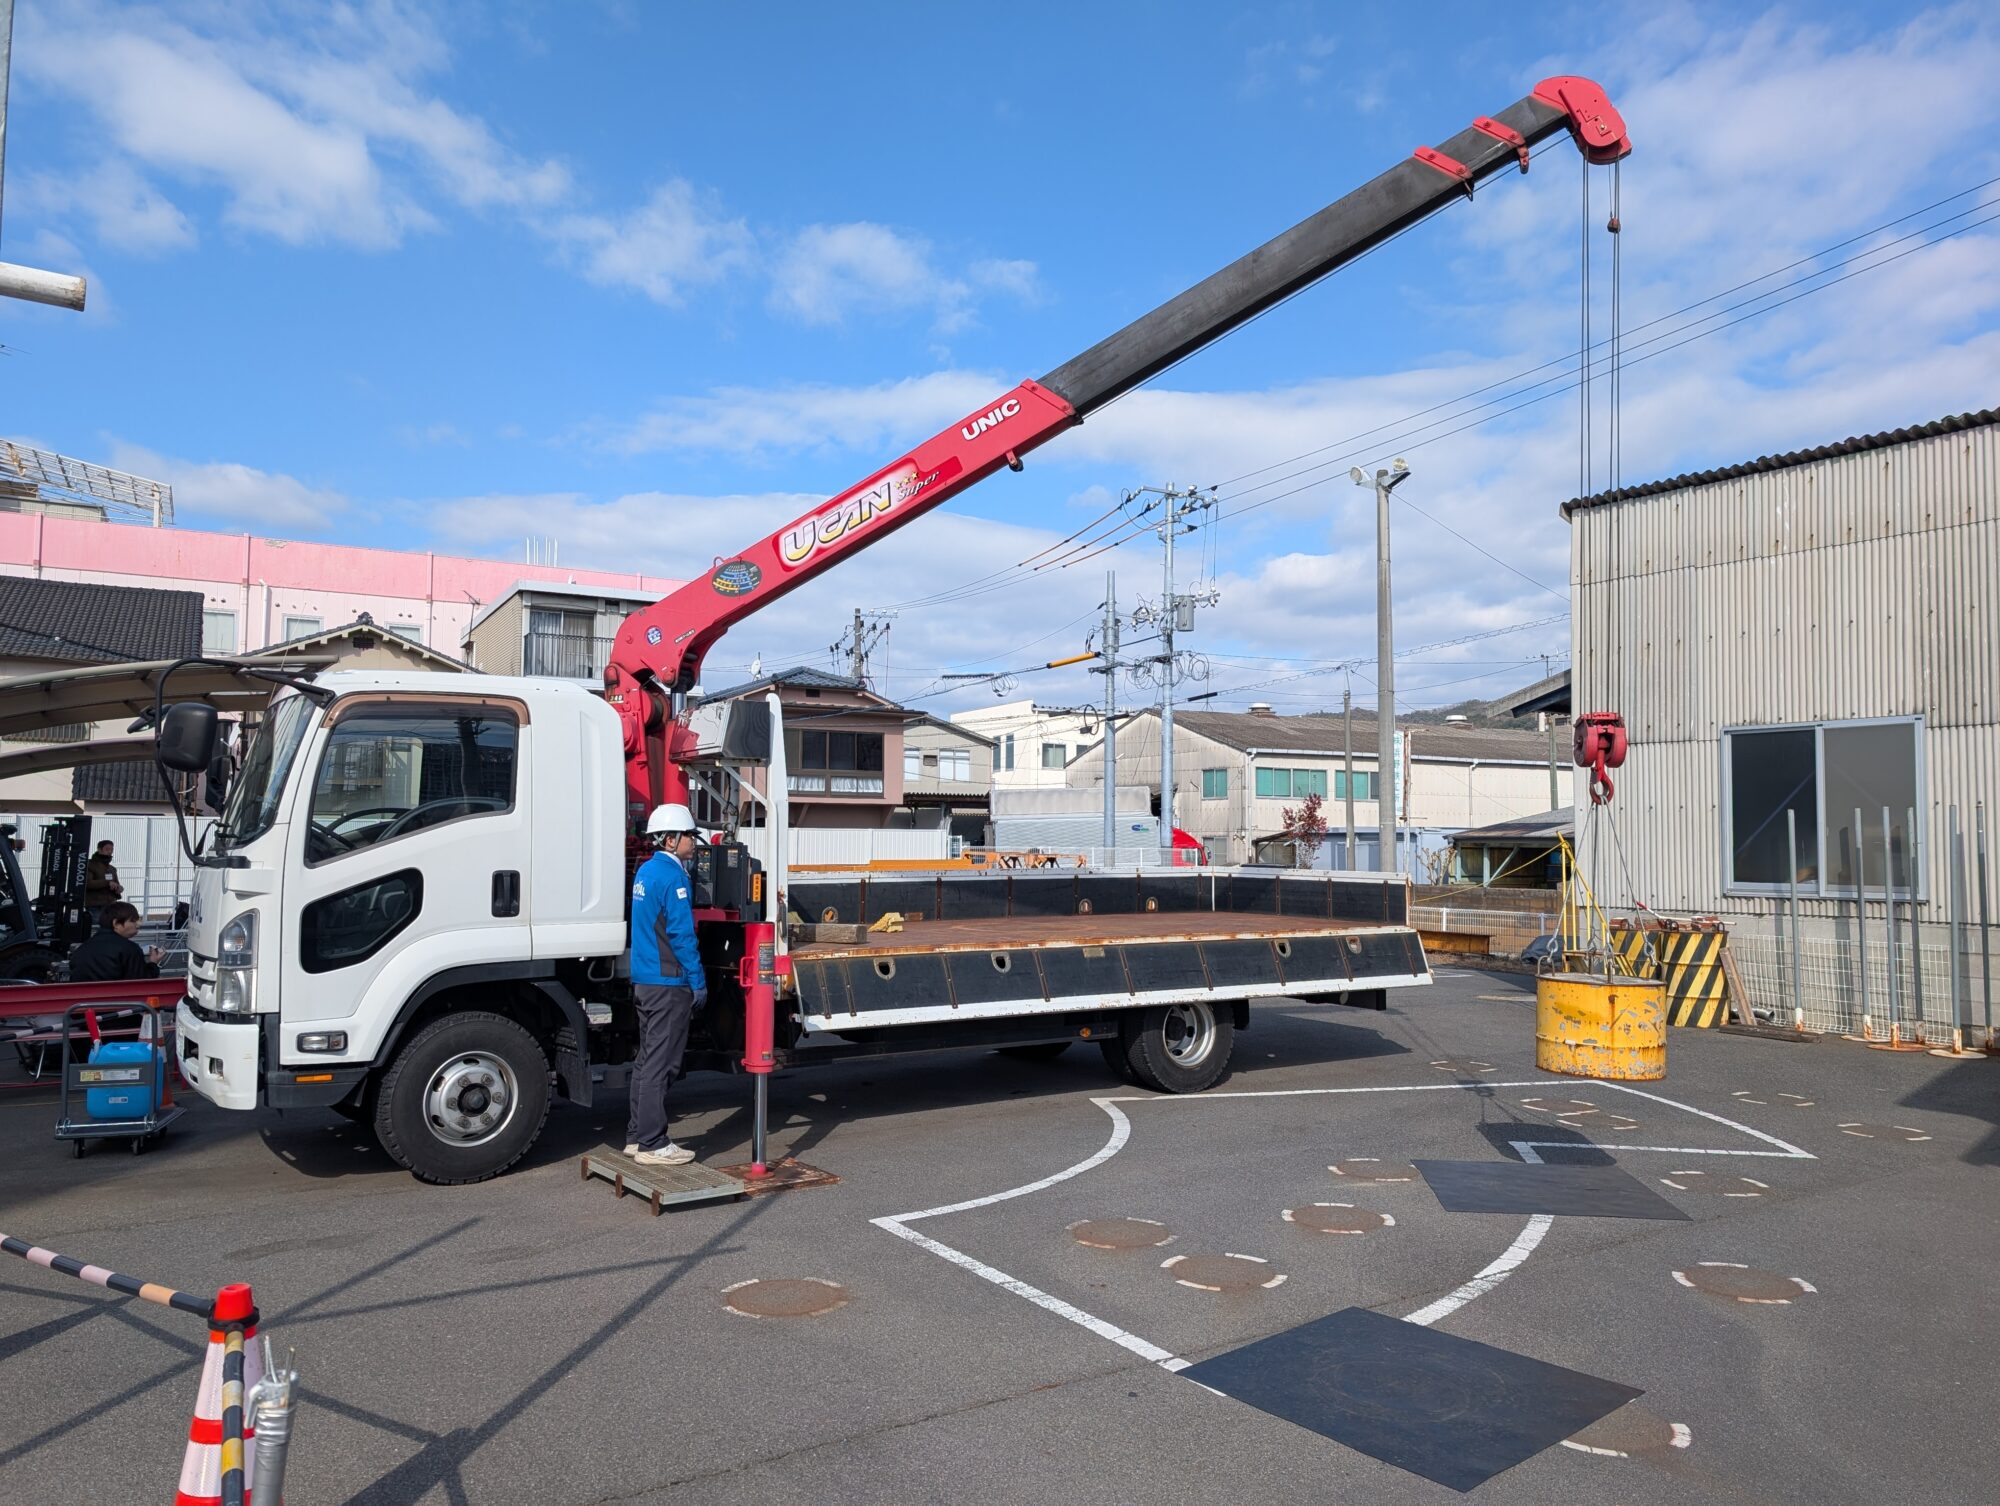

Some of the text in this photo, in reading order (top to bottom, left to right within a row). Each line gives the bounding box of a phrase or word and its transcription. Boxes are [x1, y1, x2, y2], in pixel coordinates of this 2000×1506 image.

[961, 398, 1022, 441] UNIC
[783, 471, 940, 562] UCAN Super
[53, 848, 61, 872] TOYOTA
[75, 852, 87, 887] TOYOTA
